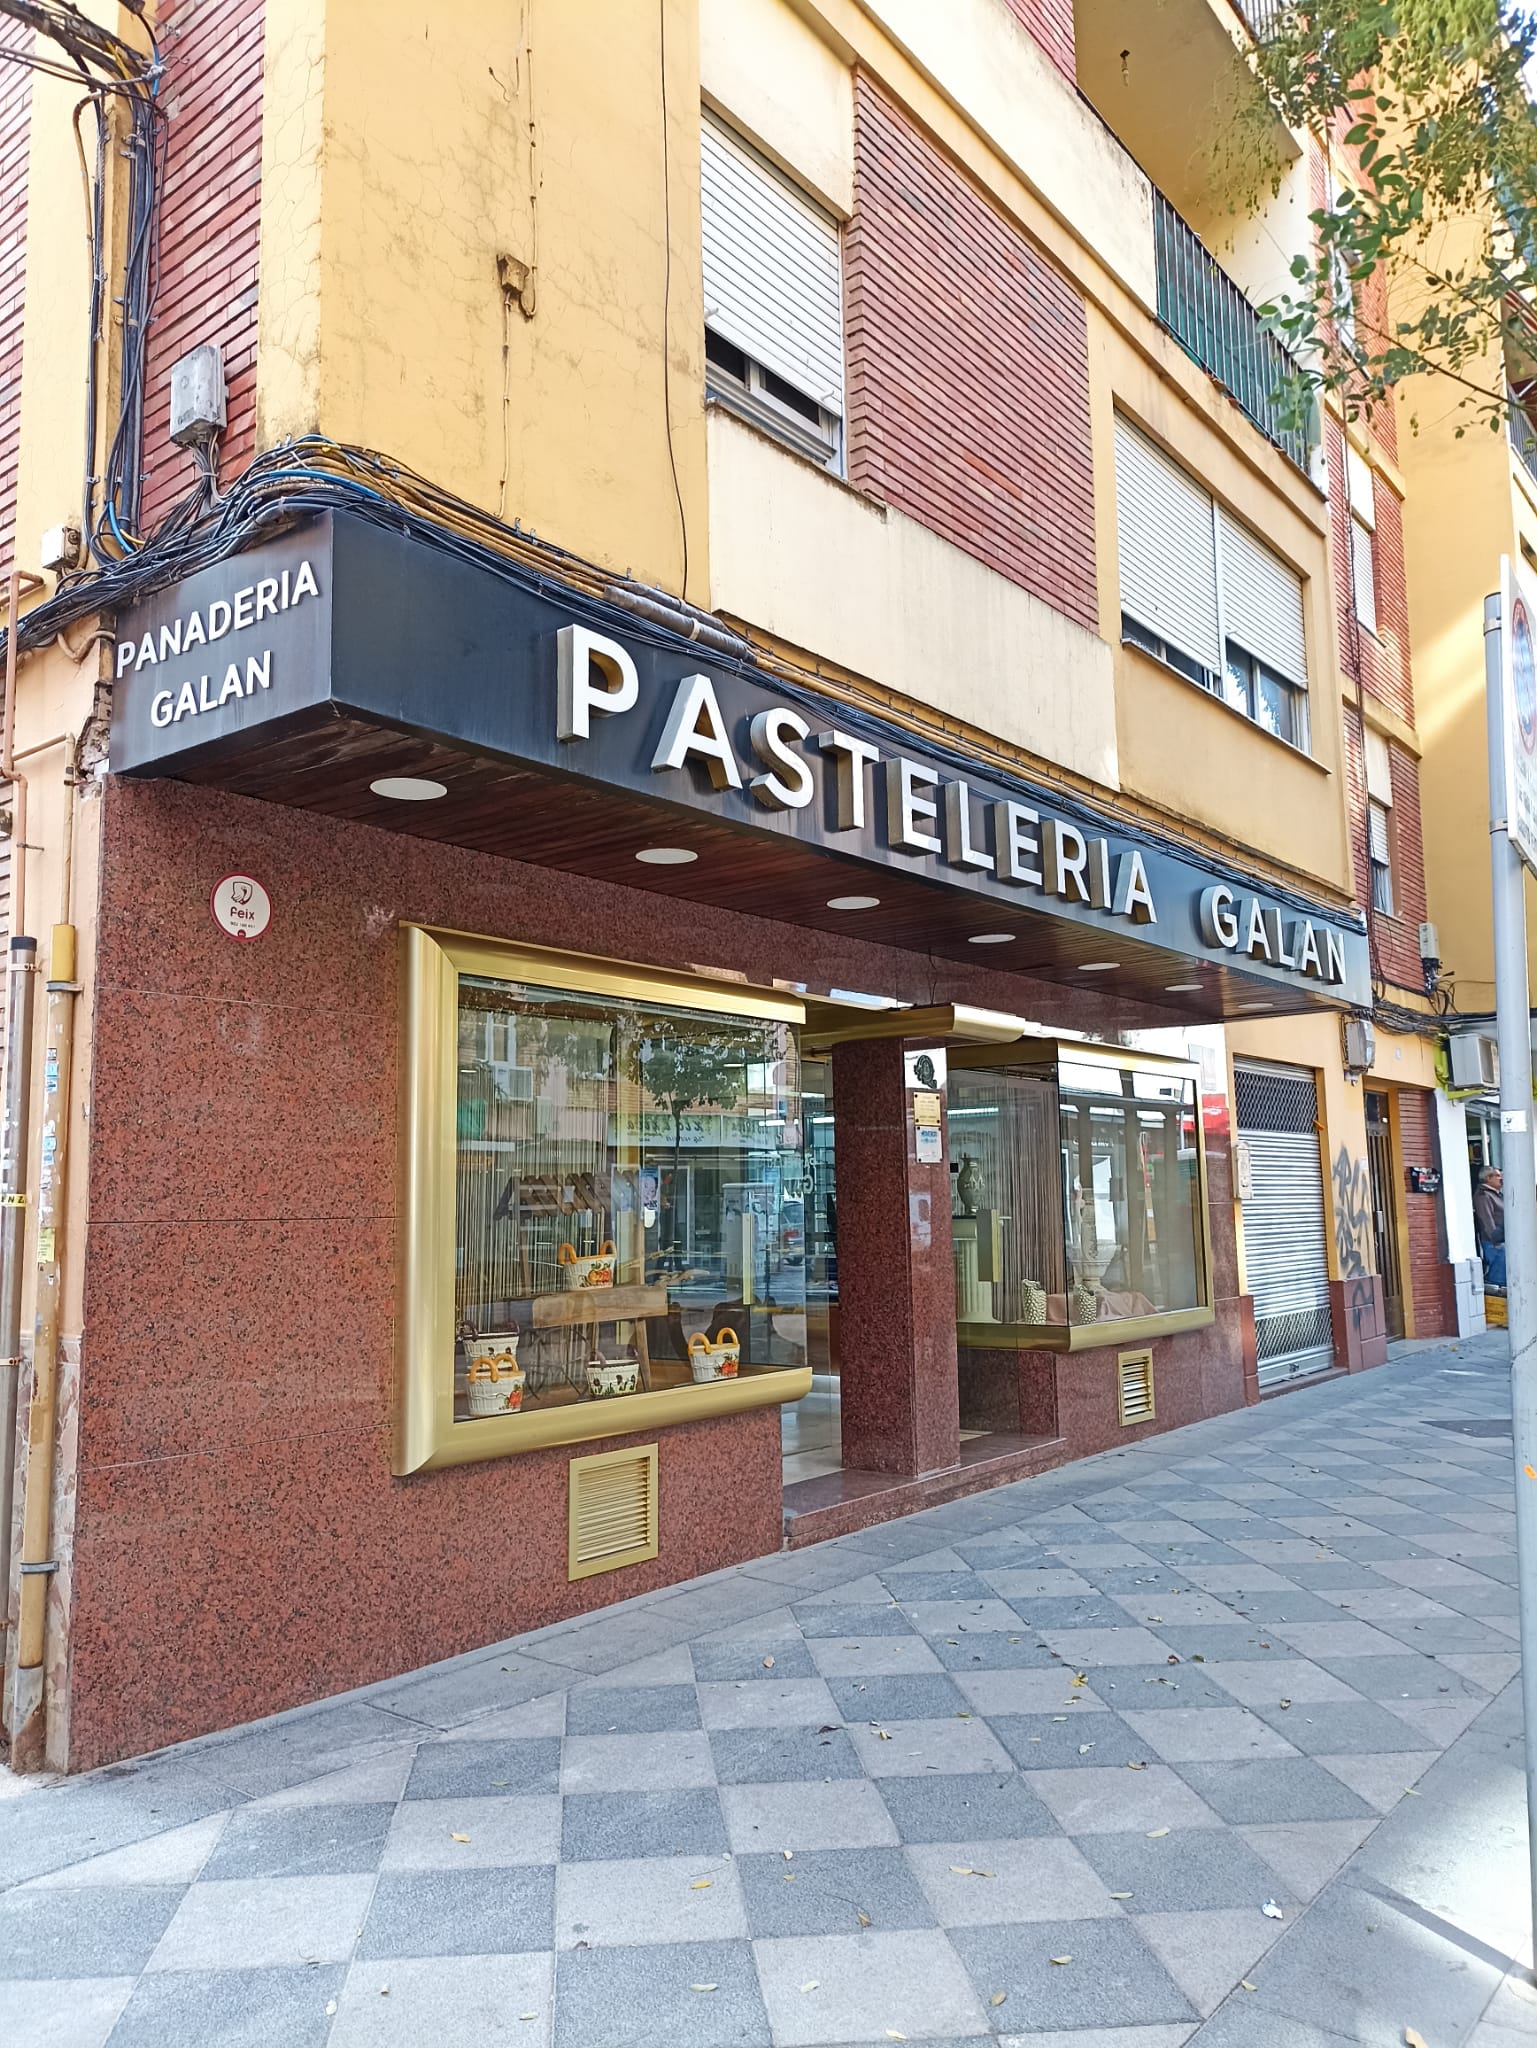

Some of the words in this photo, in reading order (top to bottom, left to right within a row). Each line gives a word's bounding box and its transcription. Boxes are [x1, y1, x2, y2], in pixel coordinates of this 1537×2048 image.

[116, 560, 319, 679] PANADERIA
[150, 650, 272, 728] GALAN
[556, 623, 1158, 925] PASTELERIA
[1199, 884, 1346, 985] GALAN
[230, 906, 255, 921] feix
